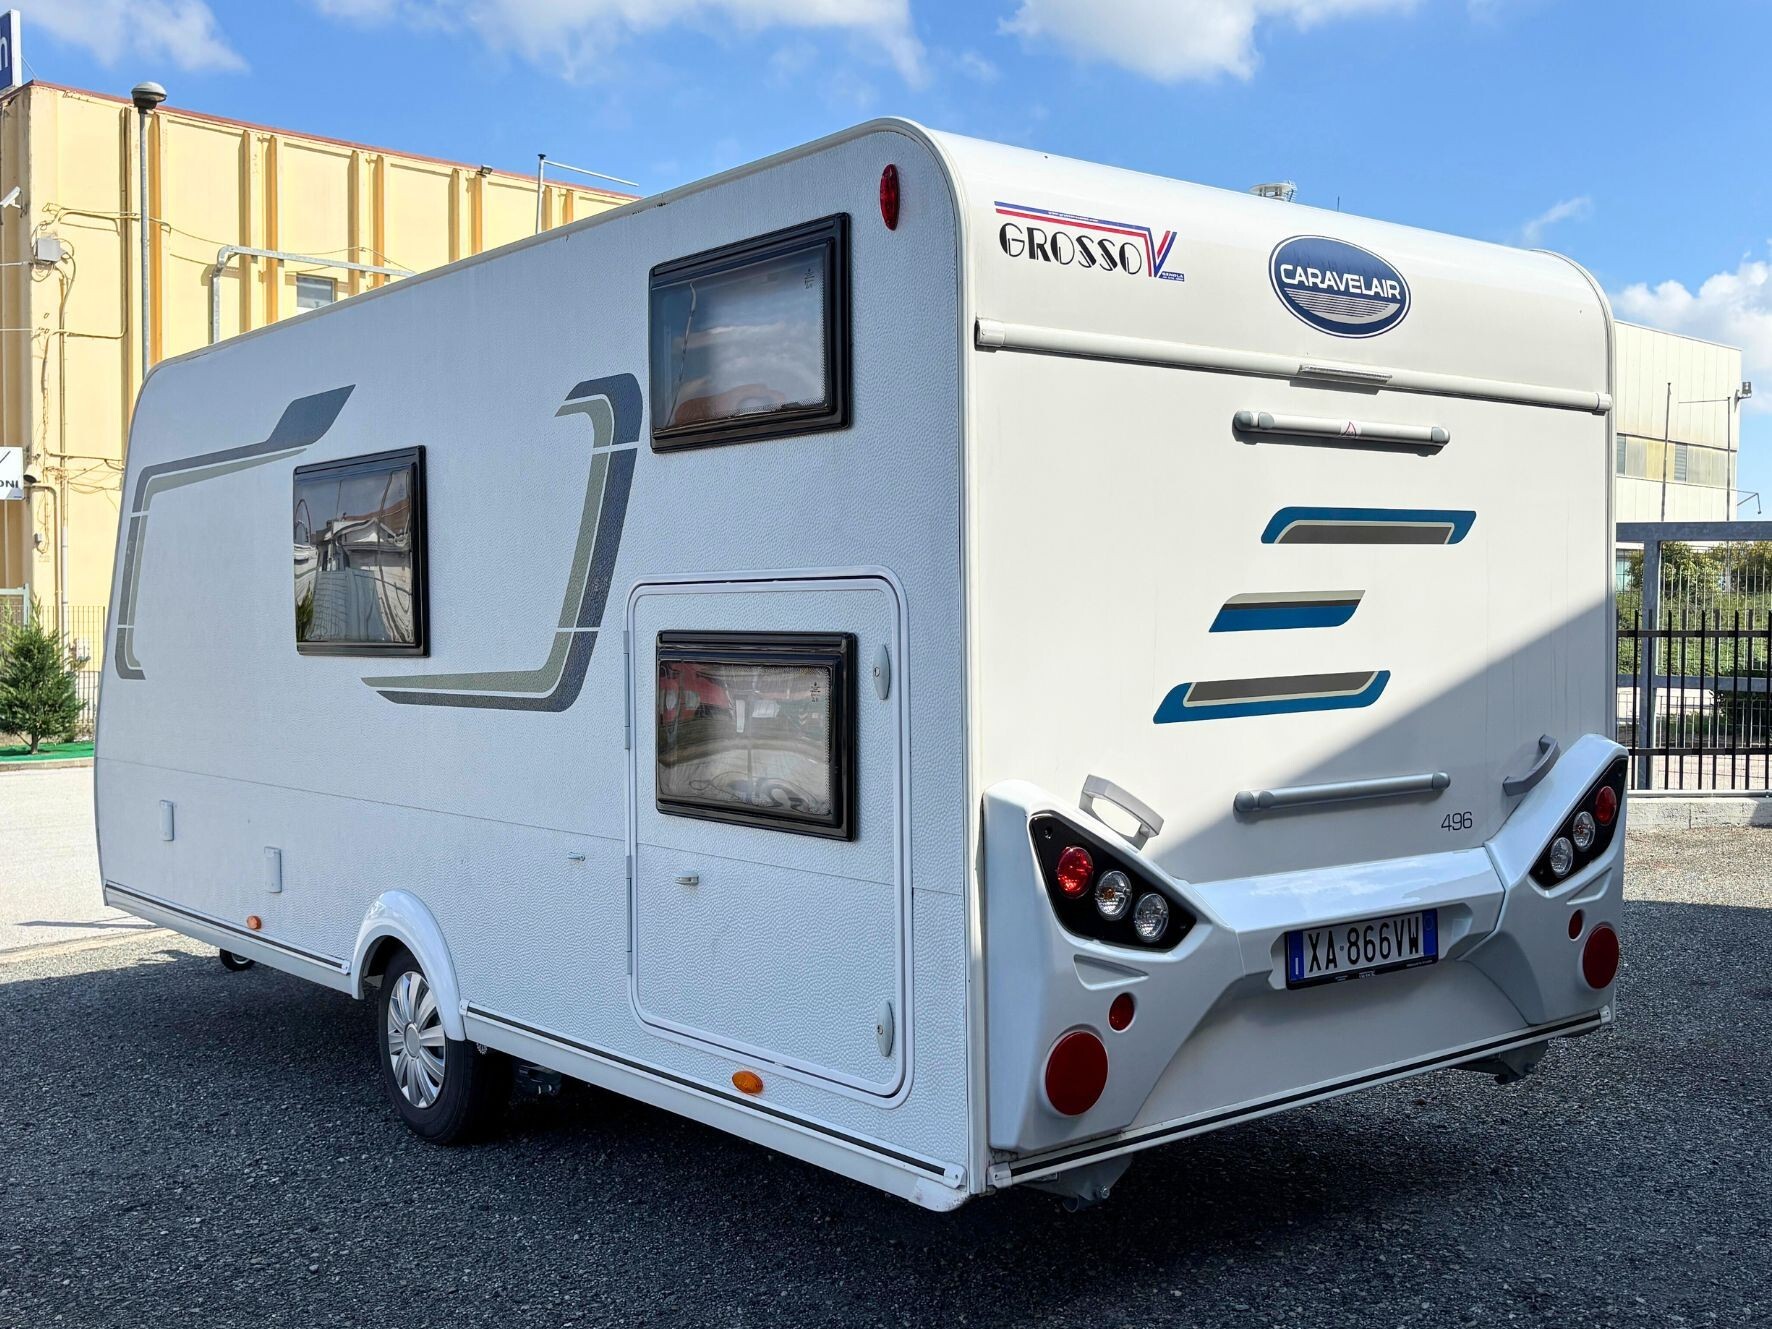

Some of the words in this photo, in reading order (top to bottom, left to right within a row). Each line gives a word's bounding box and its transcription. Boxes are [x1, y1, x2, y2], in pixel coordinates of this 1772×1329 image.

[998, 222, 1143, 275] GROSSO
[1280, 263, 1401, 300] CARAVELAIR
[1440, 811, 1473, 832] 496
